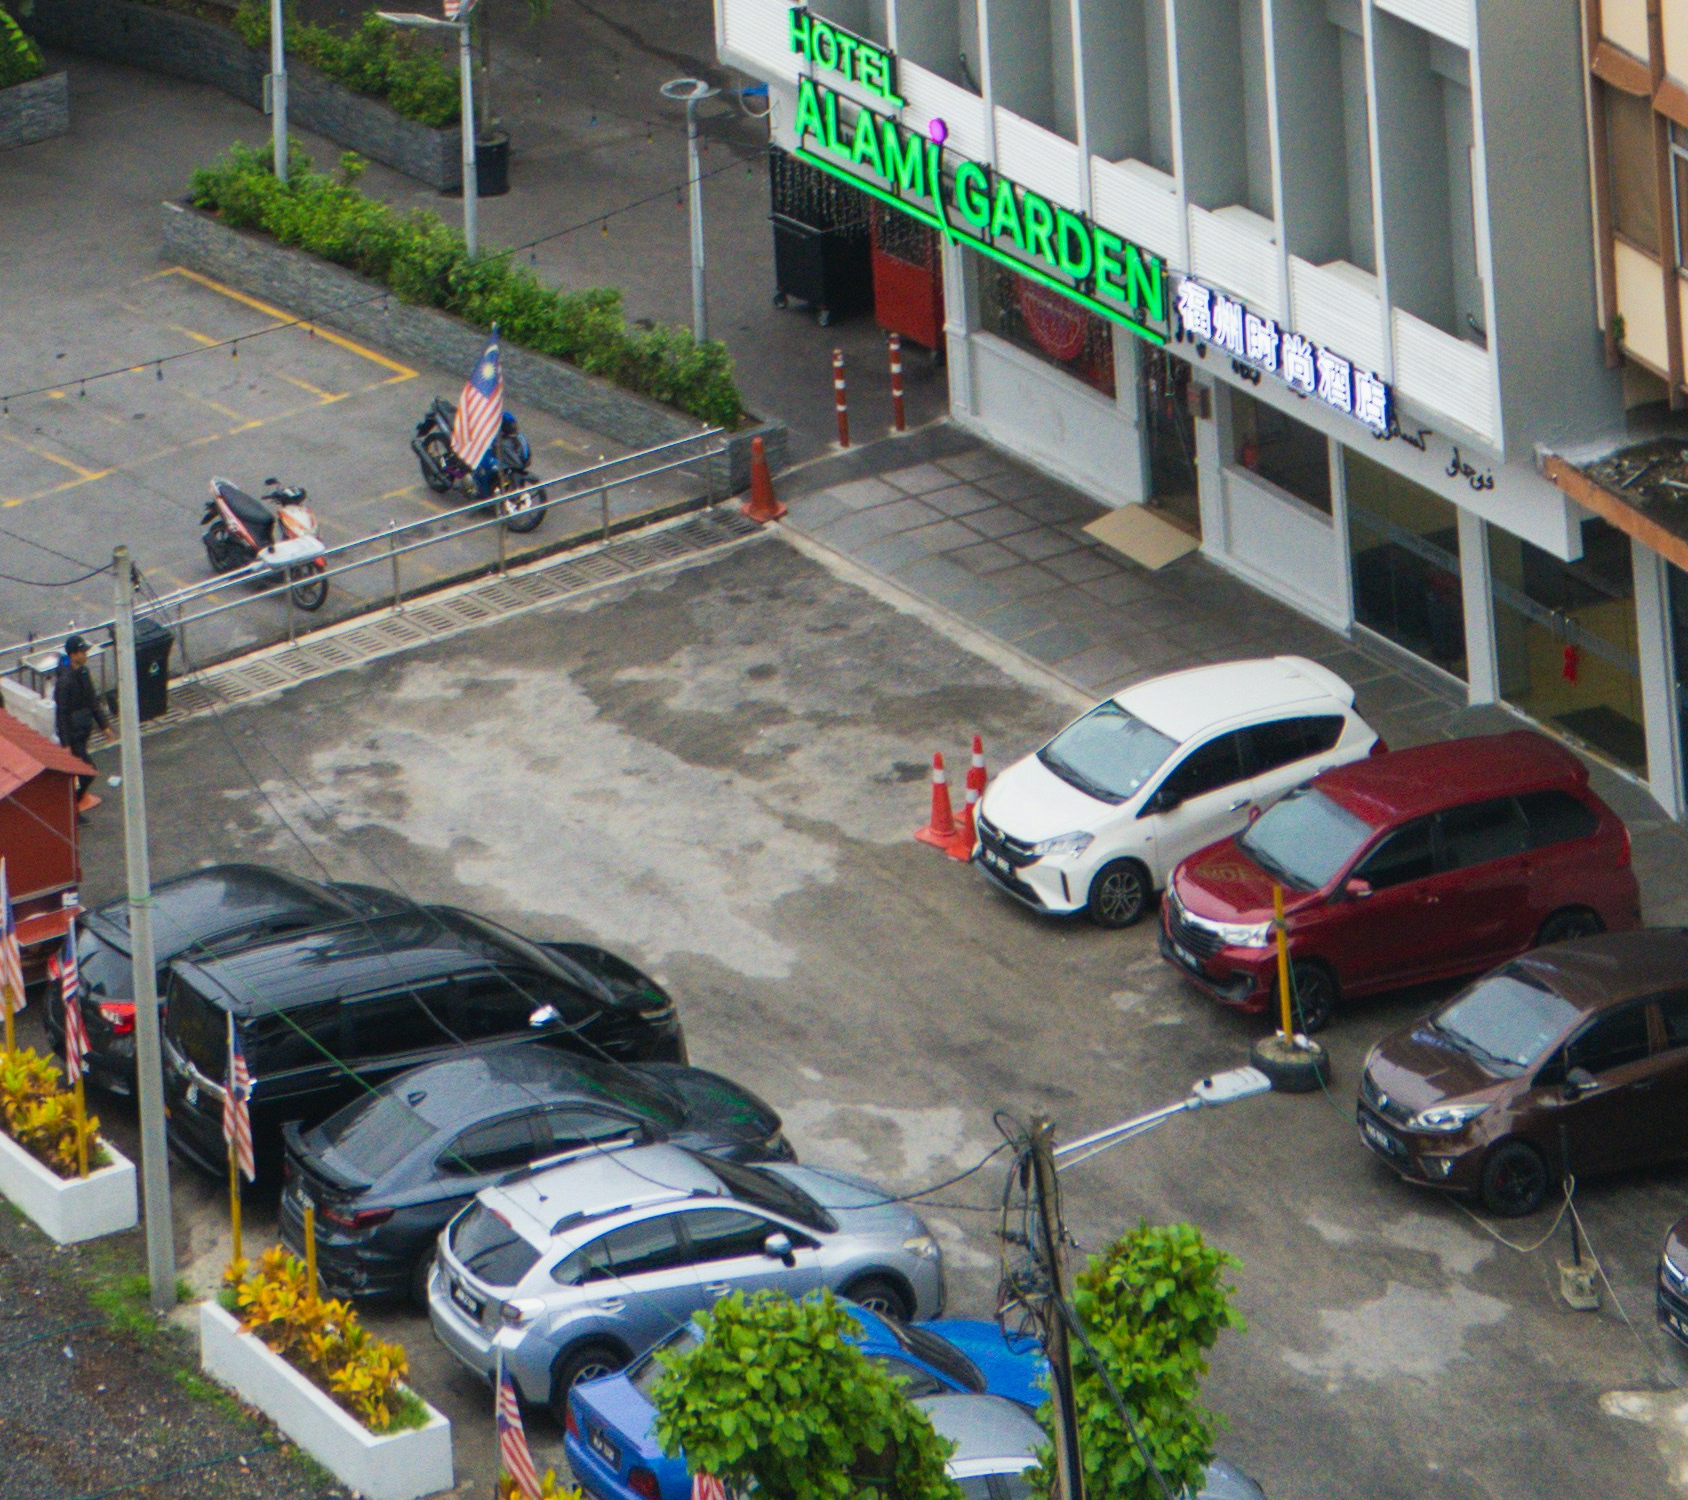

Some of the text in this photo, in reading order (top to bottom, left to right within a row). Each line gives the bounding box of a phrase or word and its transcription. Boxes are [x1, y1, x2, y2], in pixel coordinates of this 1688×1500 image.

[788, 5, 905, 109] HOTEL
[955, 160, 1165, 323] GARDEN
[1178, 275, 1389, 432] 福州时尚酒店
